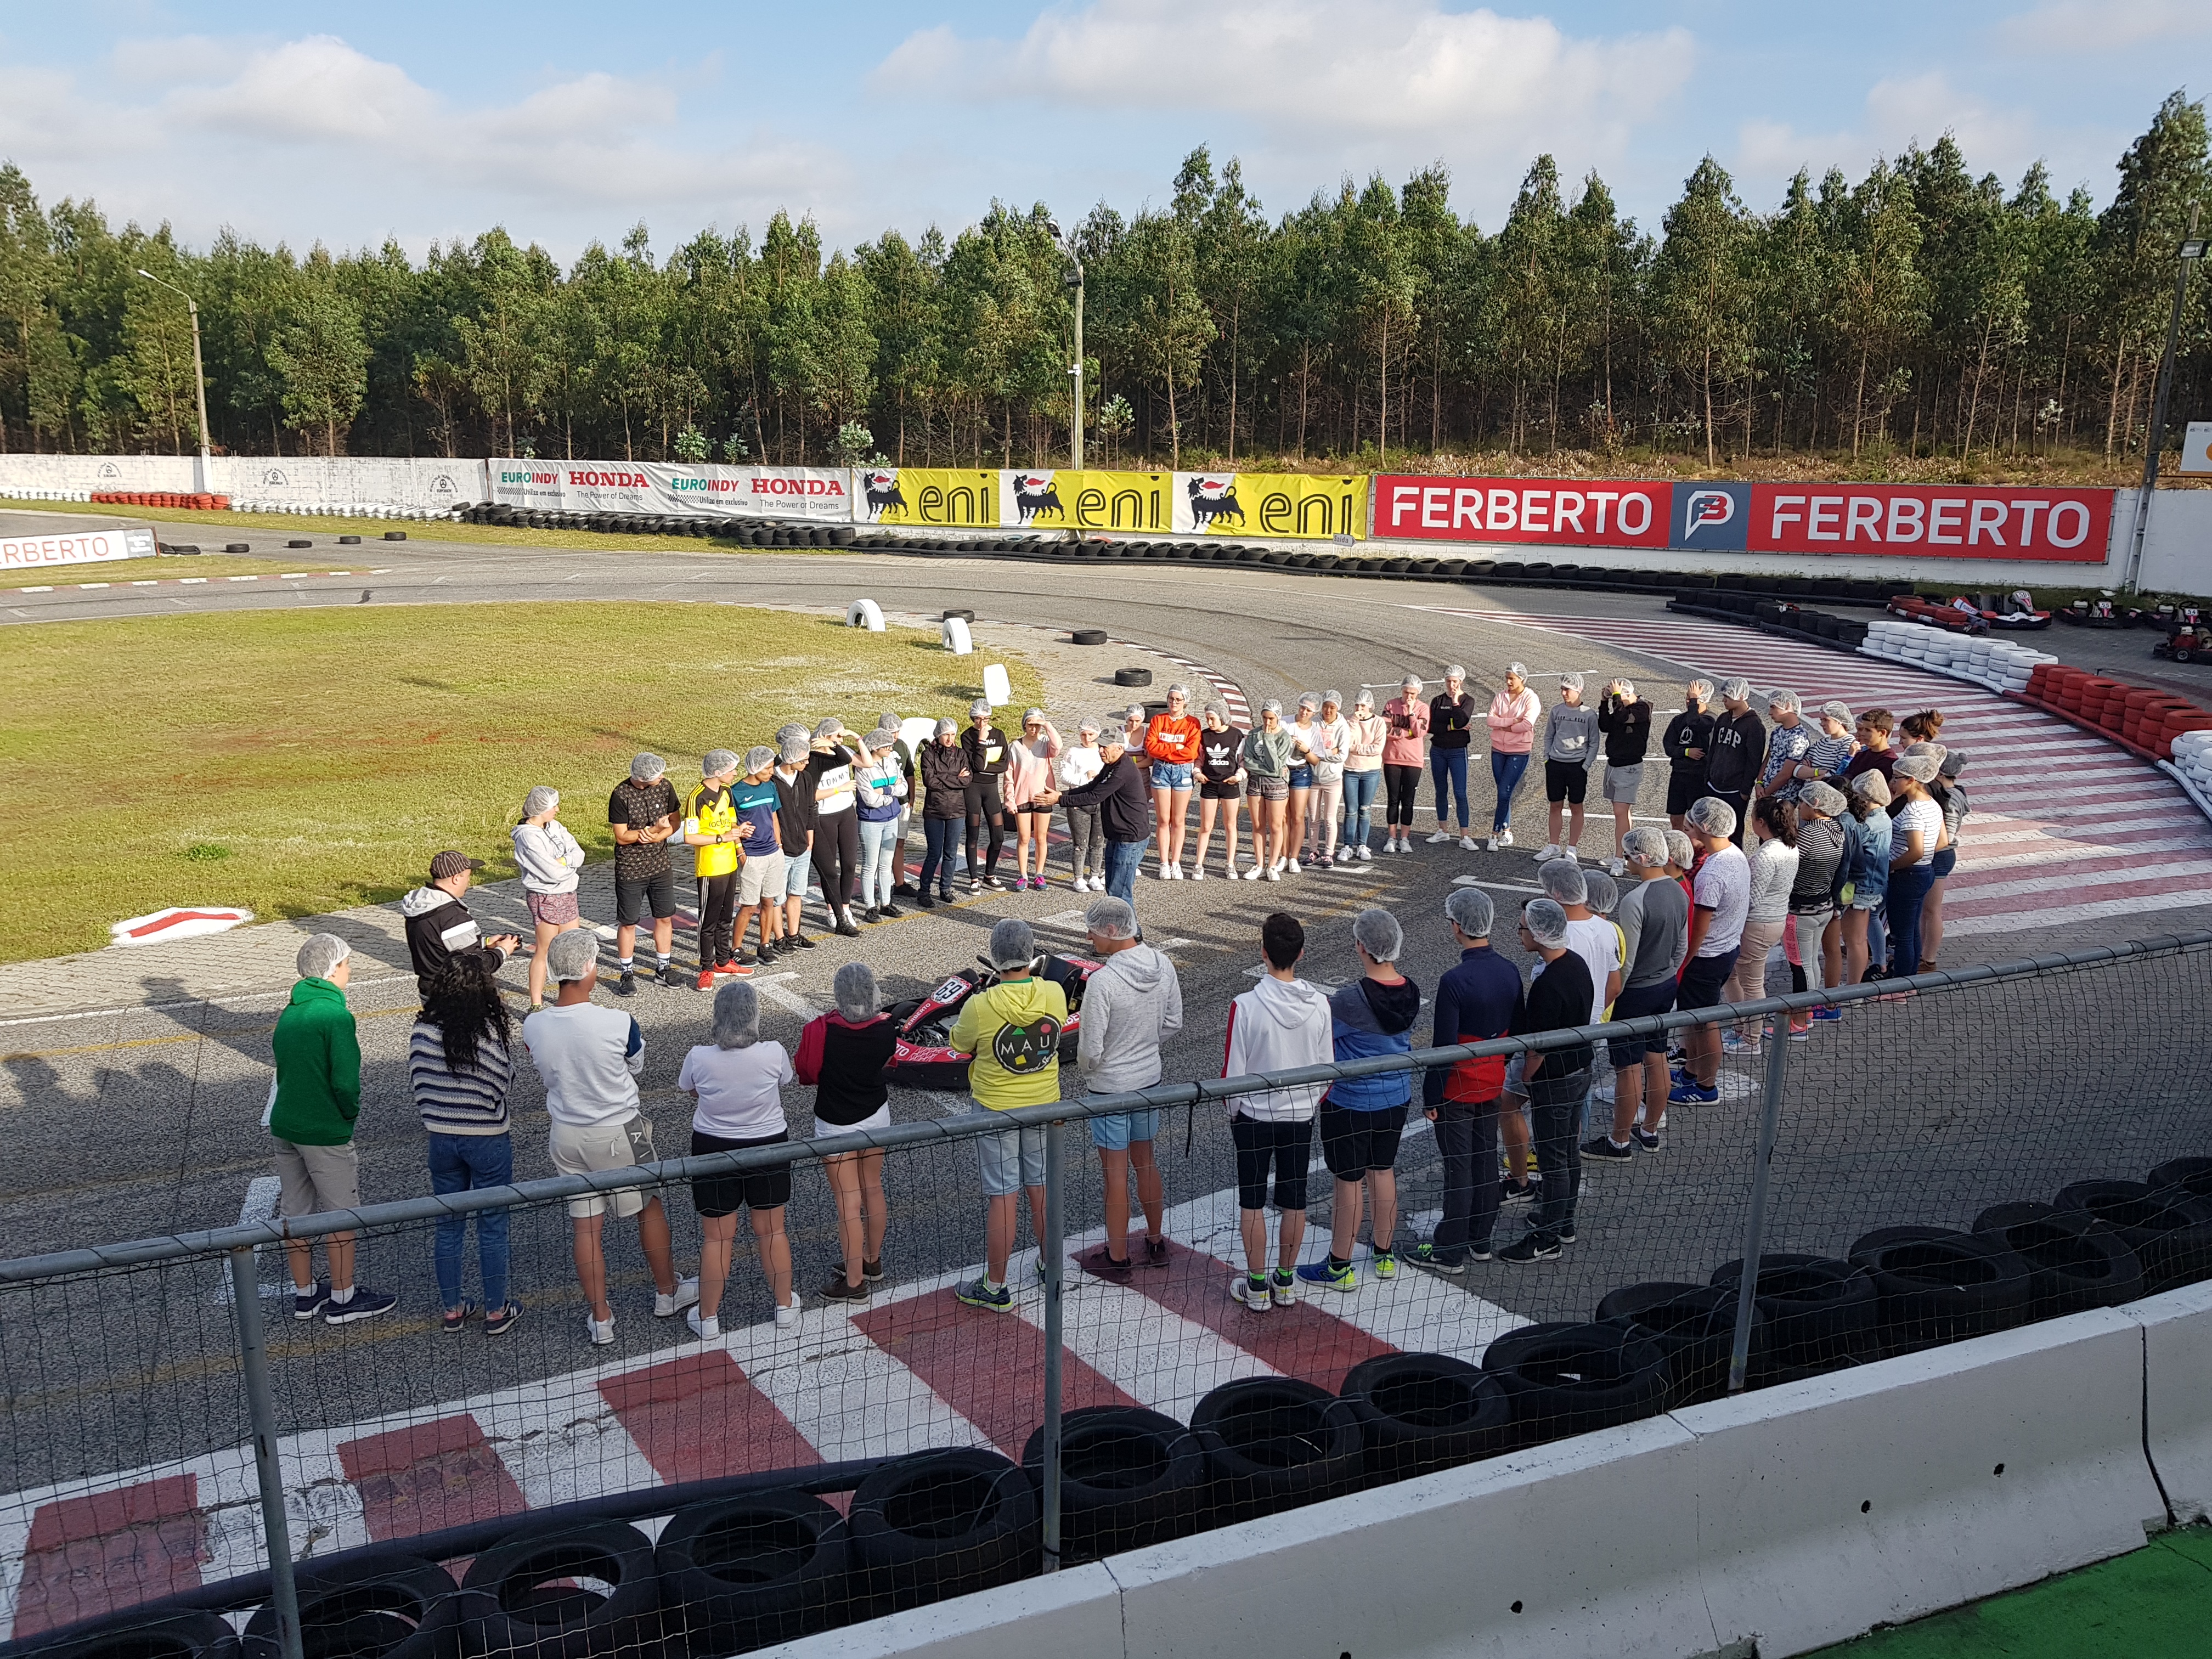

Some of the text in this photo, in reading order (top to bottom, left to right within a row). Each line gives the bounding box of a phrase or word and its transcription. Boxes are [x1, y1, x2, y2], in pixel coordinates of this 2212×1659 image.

[501, 472, 558, 484] EUROINDY
[568, 471, 650, 487] HONDA
[672, 478, 740, 492] EUROINDY
[751, 478, 845, 495] HONDA
[619, 492, 643, 500] Dreams
[699, 496, 715, 504] Utiliza
[725, 498, 748, 506] exclusivo
[759, 499, 774, 507] The
[776, 500, 799, 509] Power
[809, 501, 839, 510] Dreams
[918, 473, 989, 524] eni
[1076, 476, 1160, 528] eni
[1260, 479, 1352, 535] eni
[1391, 486, 1652, 535] FERBERTO
[1771, 495, 2090, 549] FERBERTO
[0, 537, 109, 564] RBERTO
[1718, 727, 1741, 748] GAP
[935, 981, 963, 1000] 69
